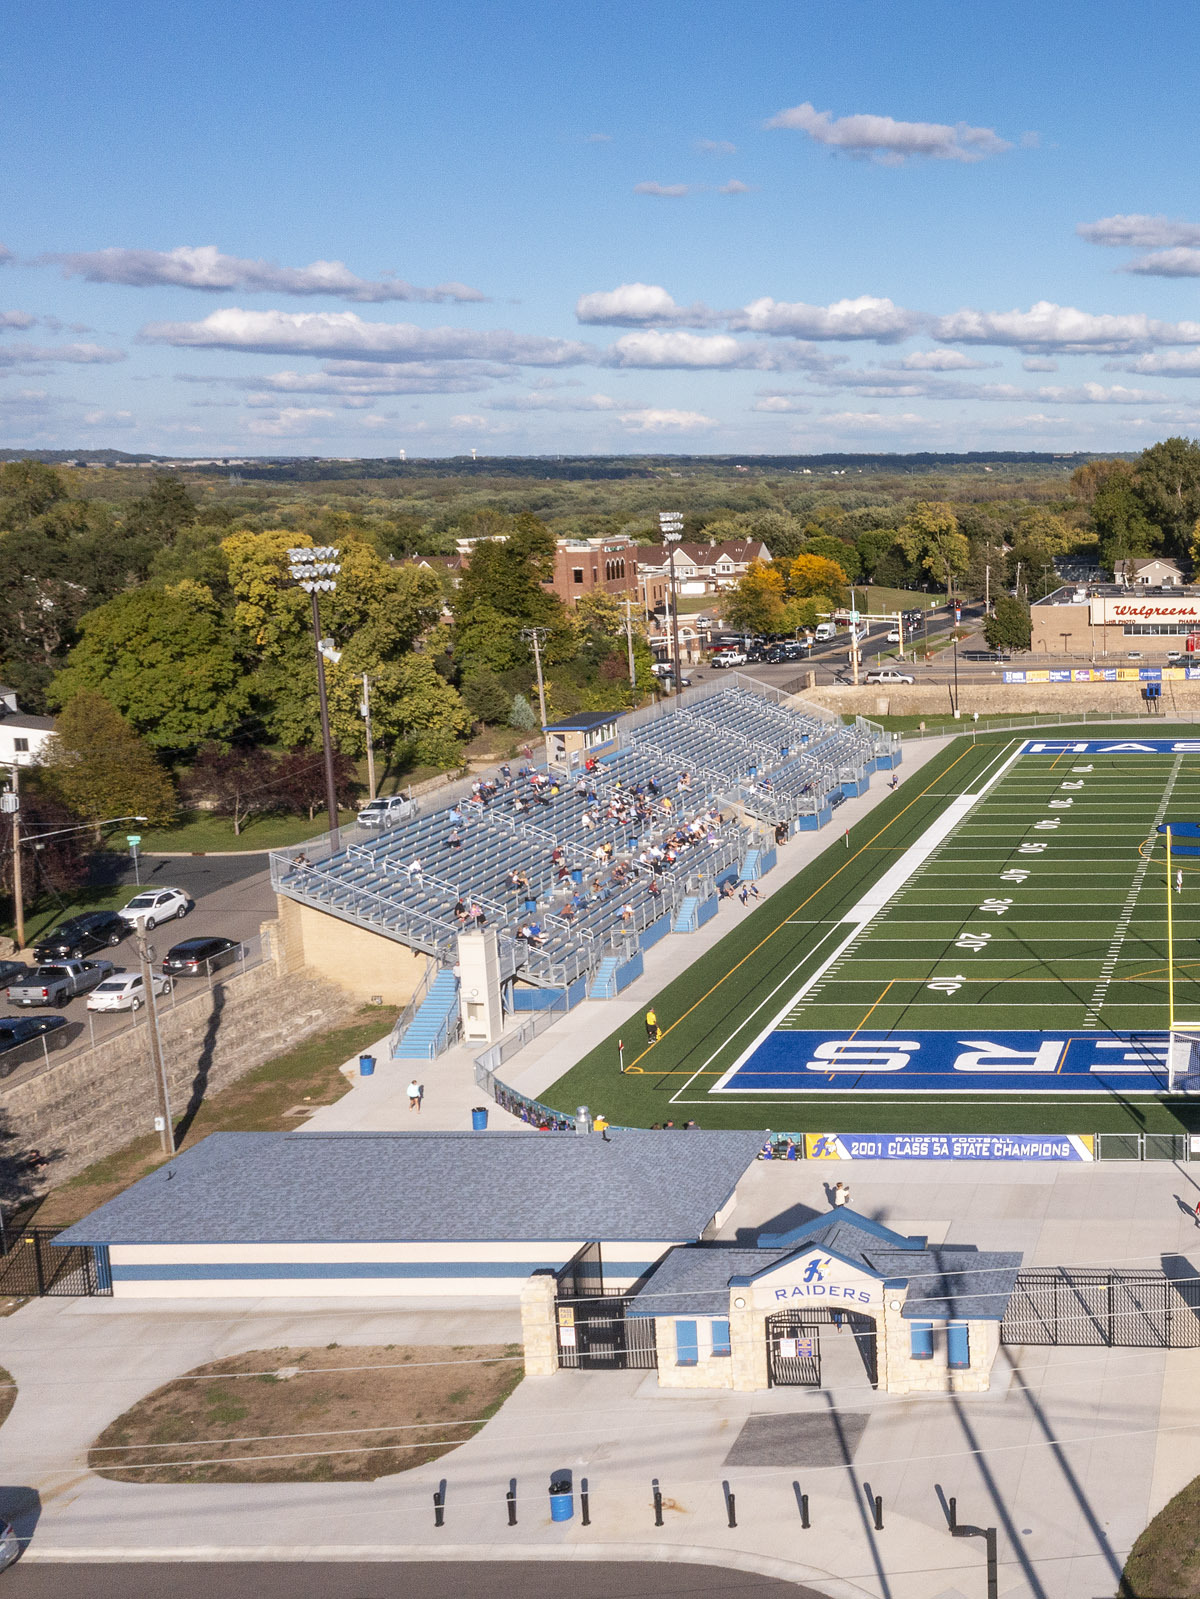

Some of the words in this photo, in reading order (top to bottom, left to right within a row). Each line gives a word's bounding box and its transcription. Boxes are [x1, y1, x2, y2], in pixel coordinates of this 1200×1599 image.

[1113, 605, 1197, 618] Walgreens
[979, 898, 1013, 911] 30
[955, 933, 992, 948] 20
[927, 975, 967, 990] 10
[851, 1142, 882, 1155] 2001
[888, 1142, 928, 1155] CLASS
[933, 1143, 949, 1155] 5A
[953, 1143, 990, 1156] STATE
[994, 1143, 1070, 1156] CHAMPIONS
[775, 1285, 871, 1303] RAIDERS
